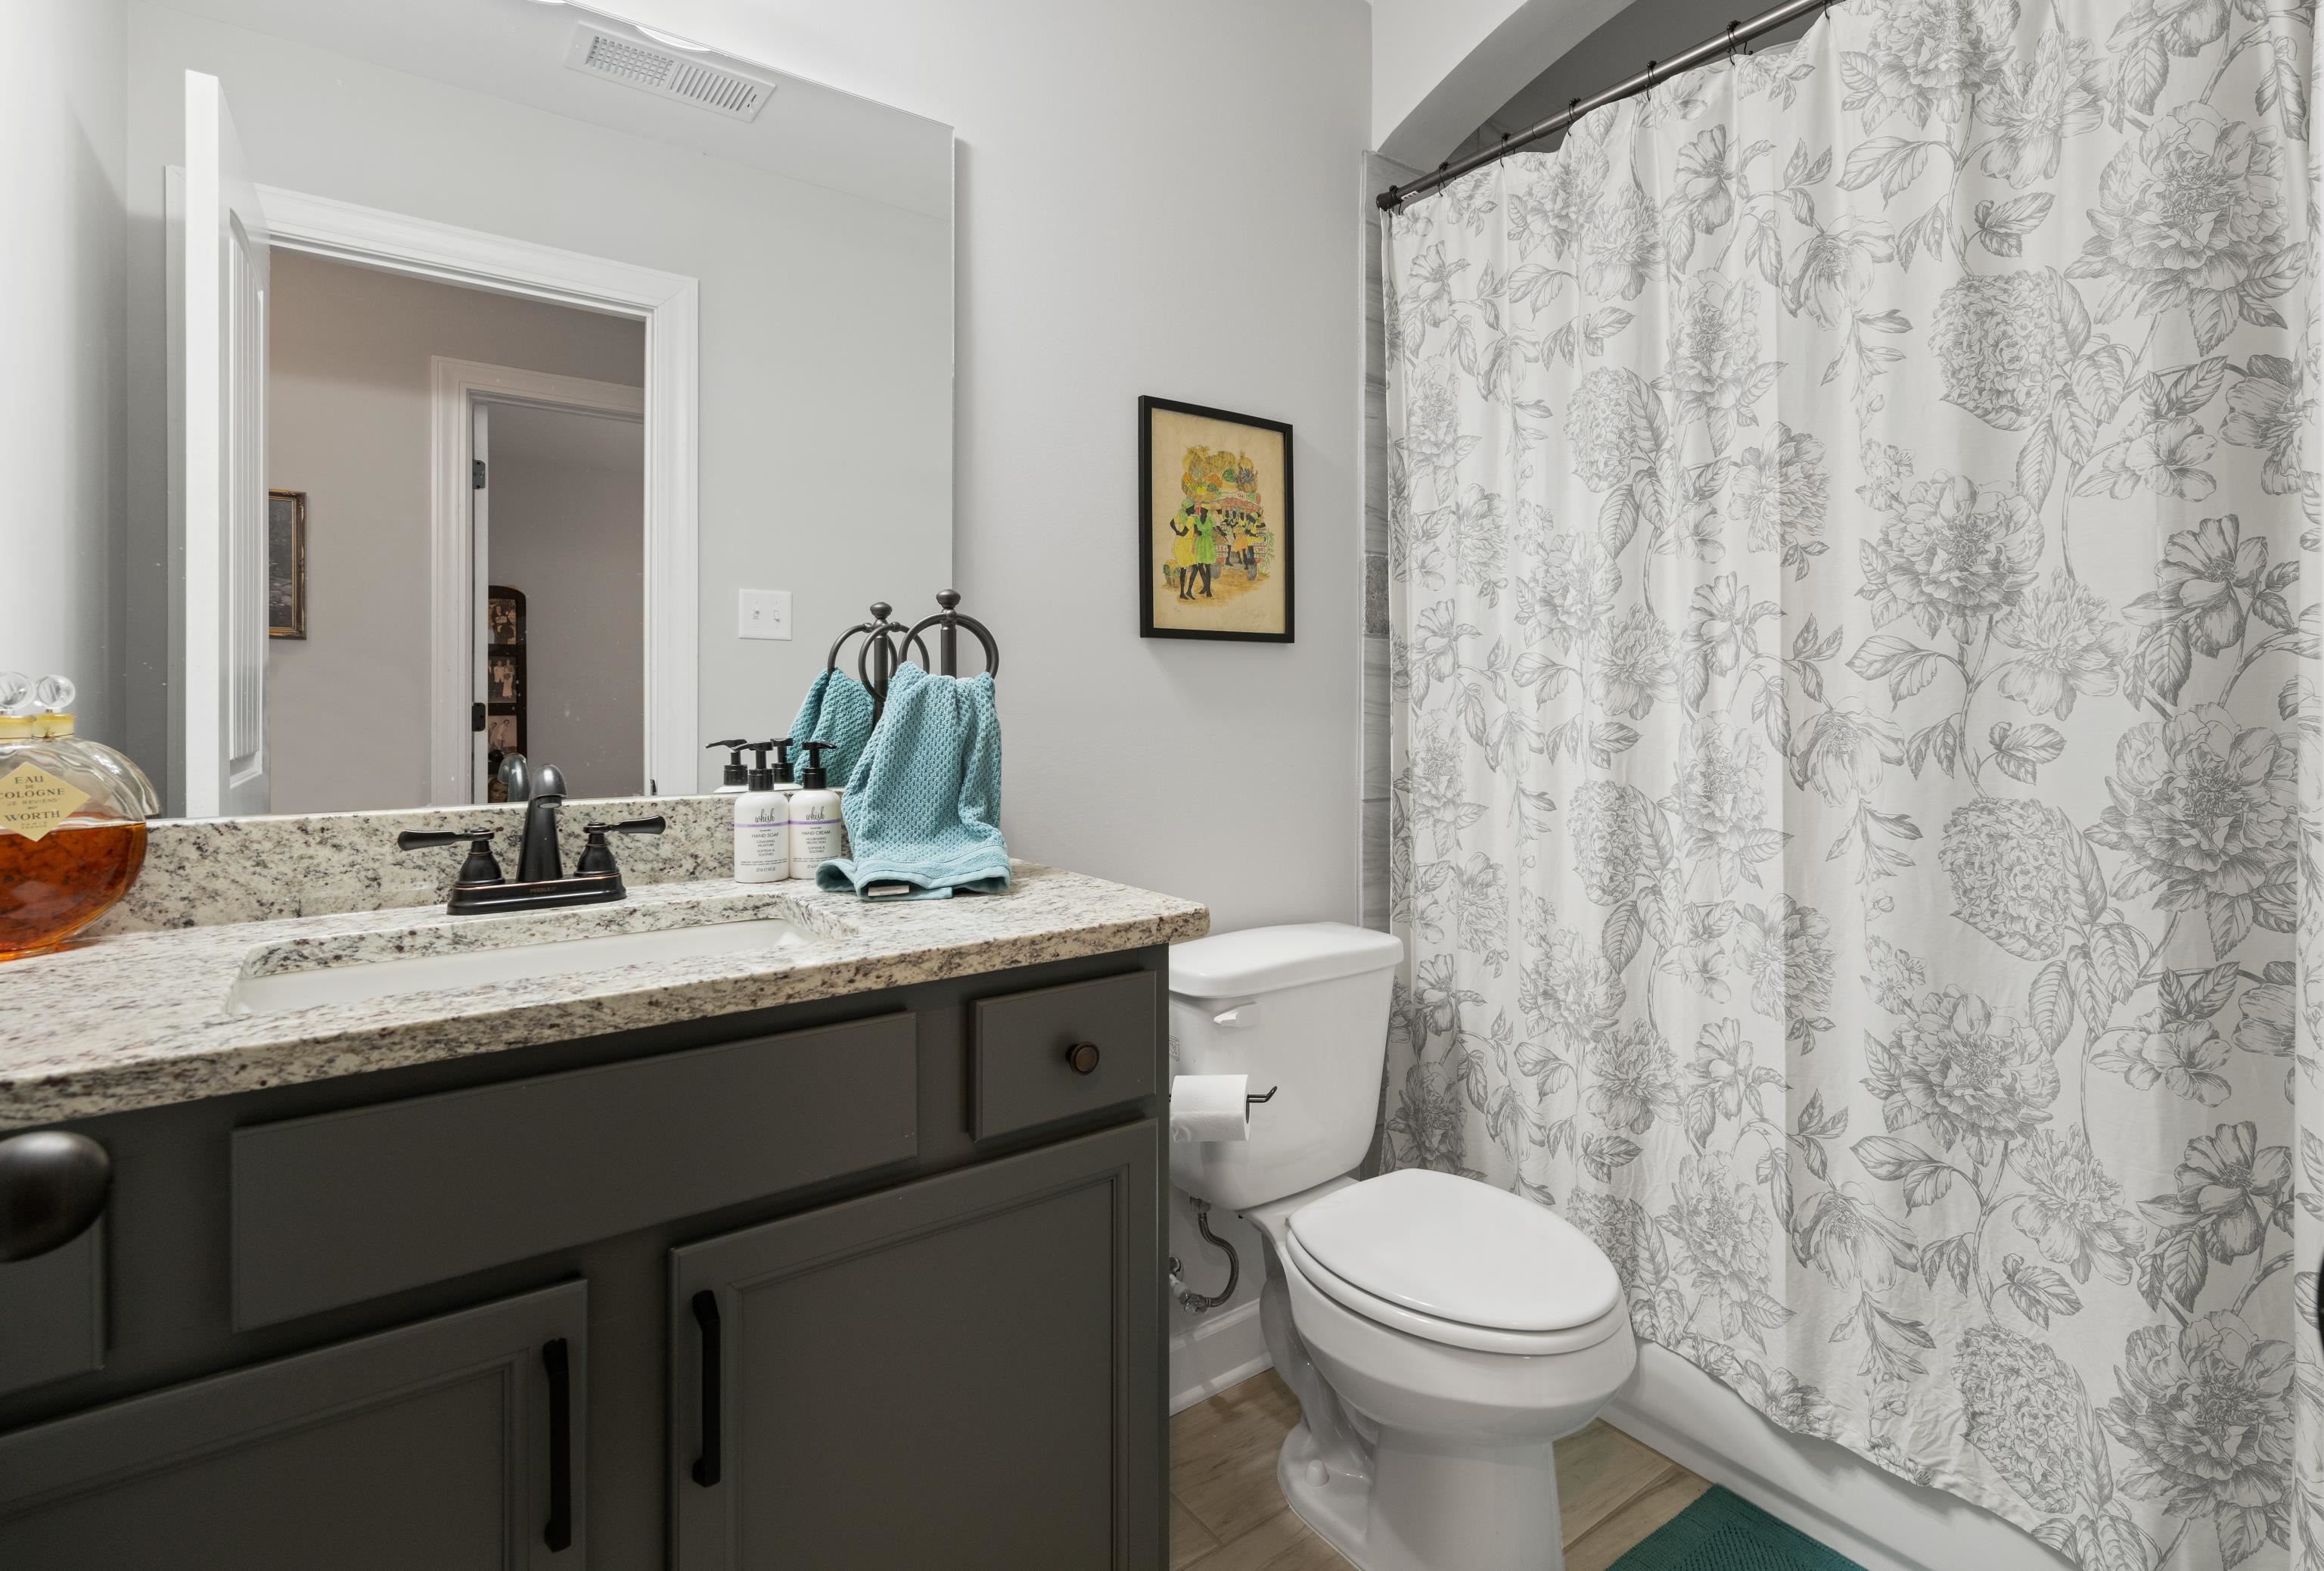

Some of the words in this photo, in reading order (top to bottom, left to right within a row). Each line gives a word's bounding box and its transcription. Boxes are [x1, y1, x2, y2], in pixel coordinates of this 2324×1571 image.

[14, 775, 44, 784] EAU
[4, 810, 60, 822] WORTH
[755, 808, 775, 823] whish
[806, 807, 825, 821] whish
